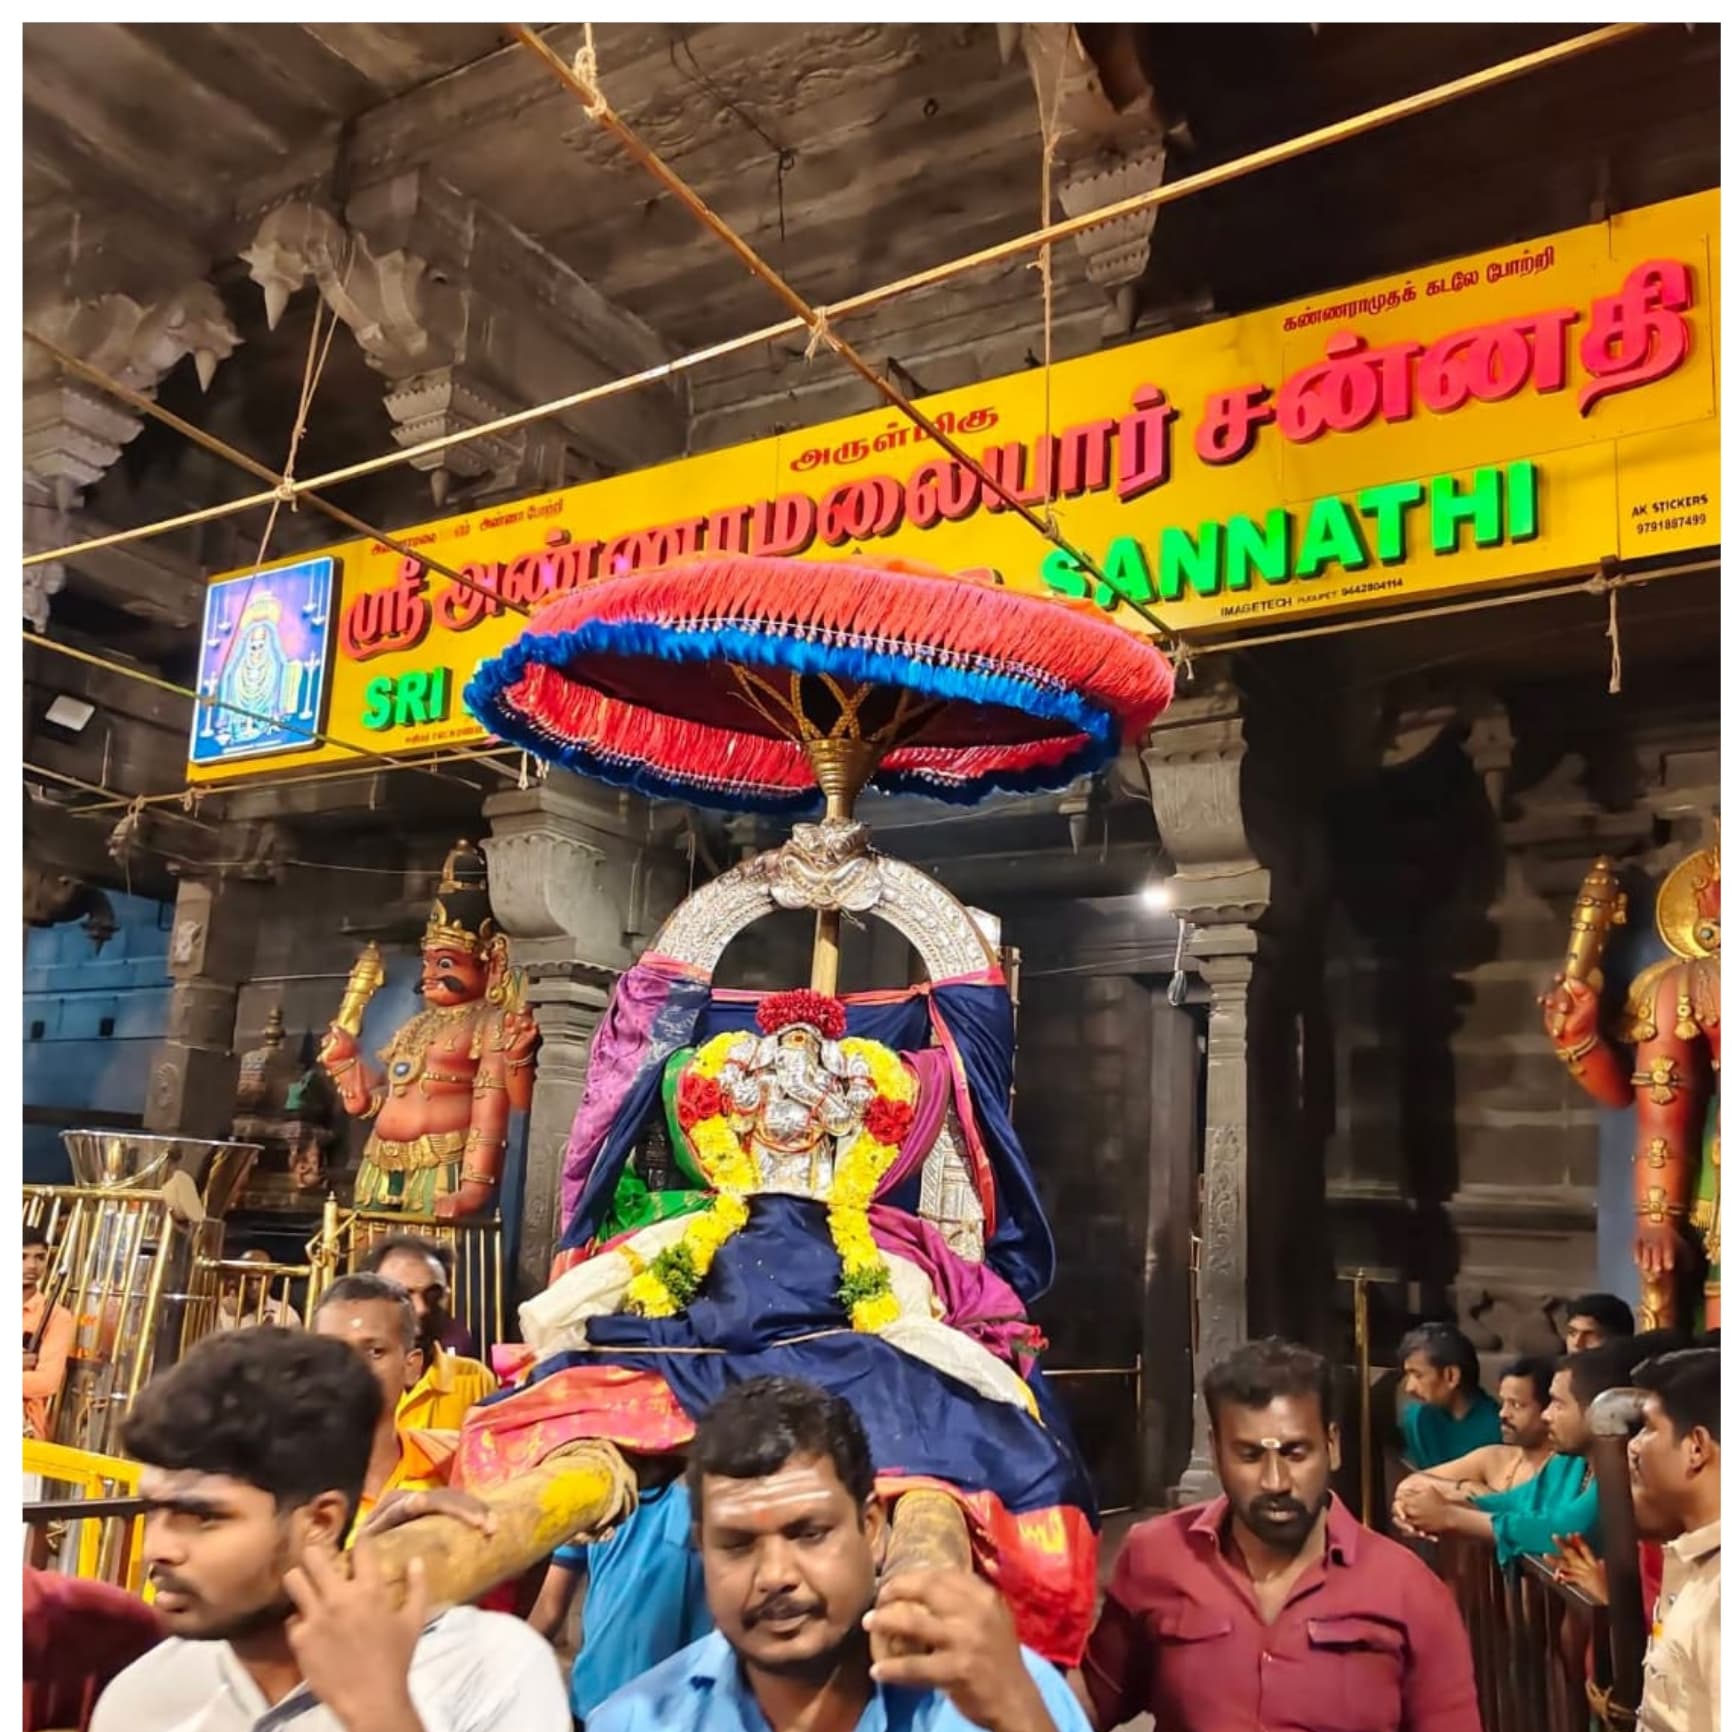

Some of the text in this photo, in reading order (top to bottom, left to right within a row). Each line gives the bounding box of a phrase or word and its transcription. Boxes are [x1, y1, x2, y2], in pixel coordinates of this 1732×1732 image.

[1486, 246, 1555, 283] போற்றி
[1194, 257, 1696, 466] சன்னதி
[789, 406, 999, 472] அருள்மிகு
[1651, 493, 1709, 513] STICKERS
[360, 458, 1540, 732] SRI SANNATHI
[1220, 597, 1293, 617] IMAGETECH
